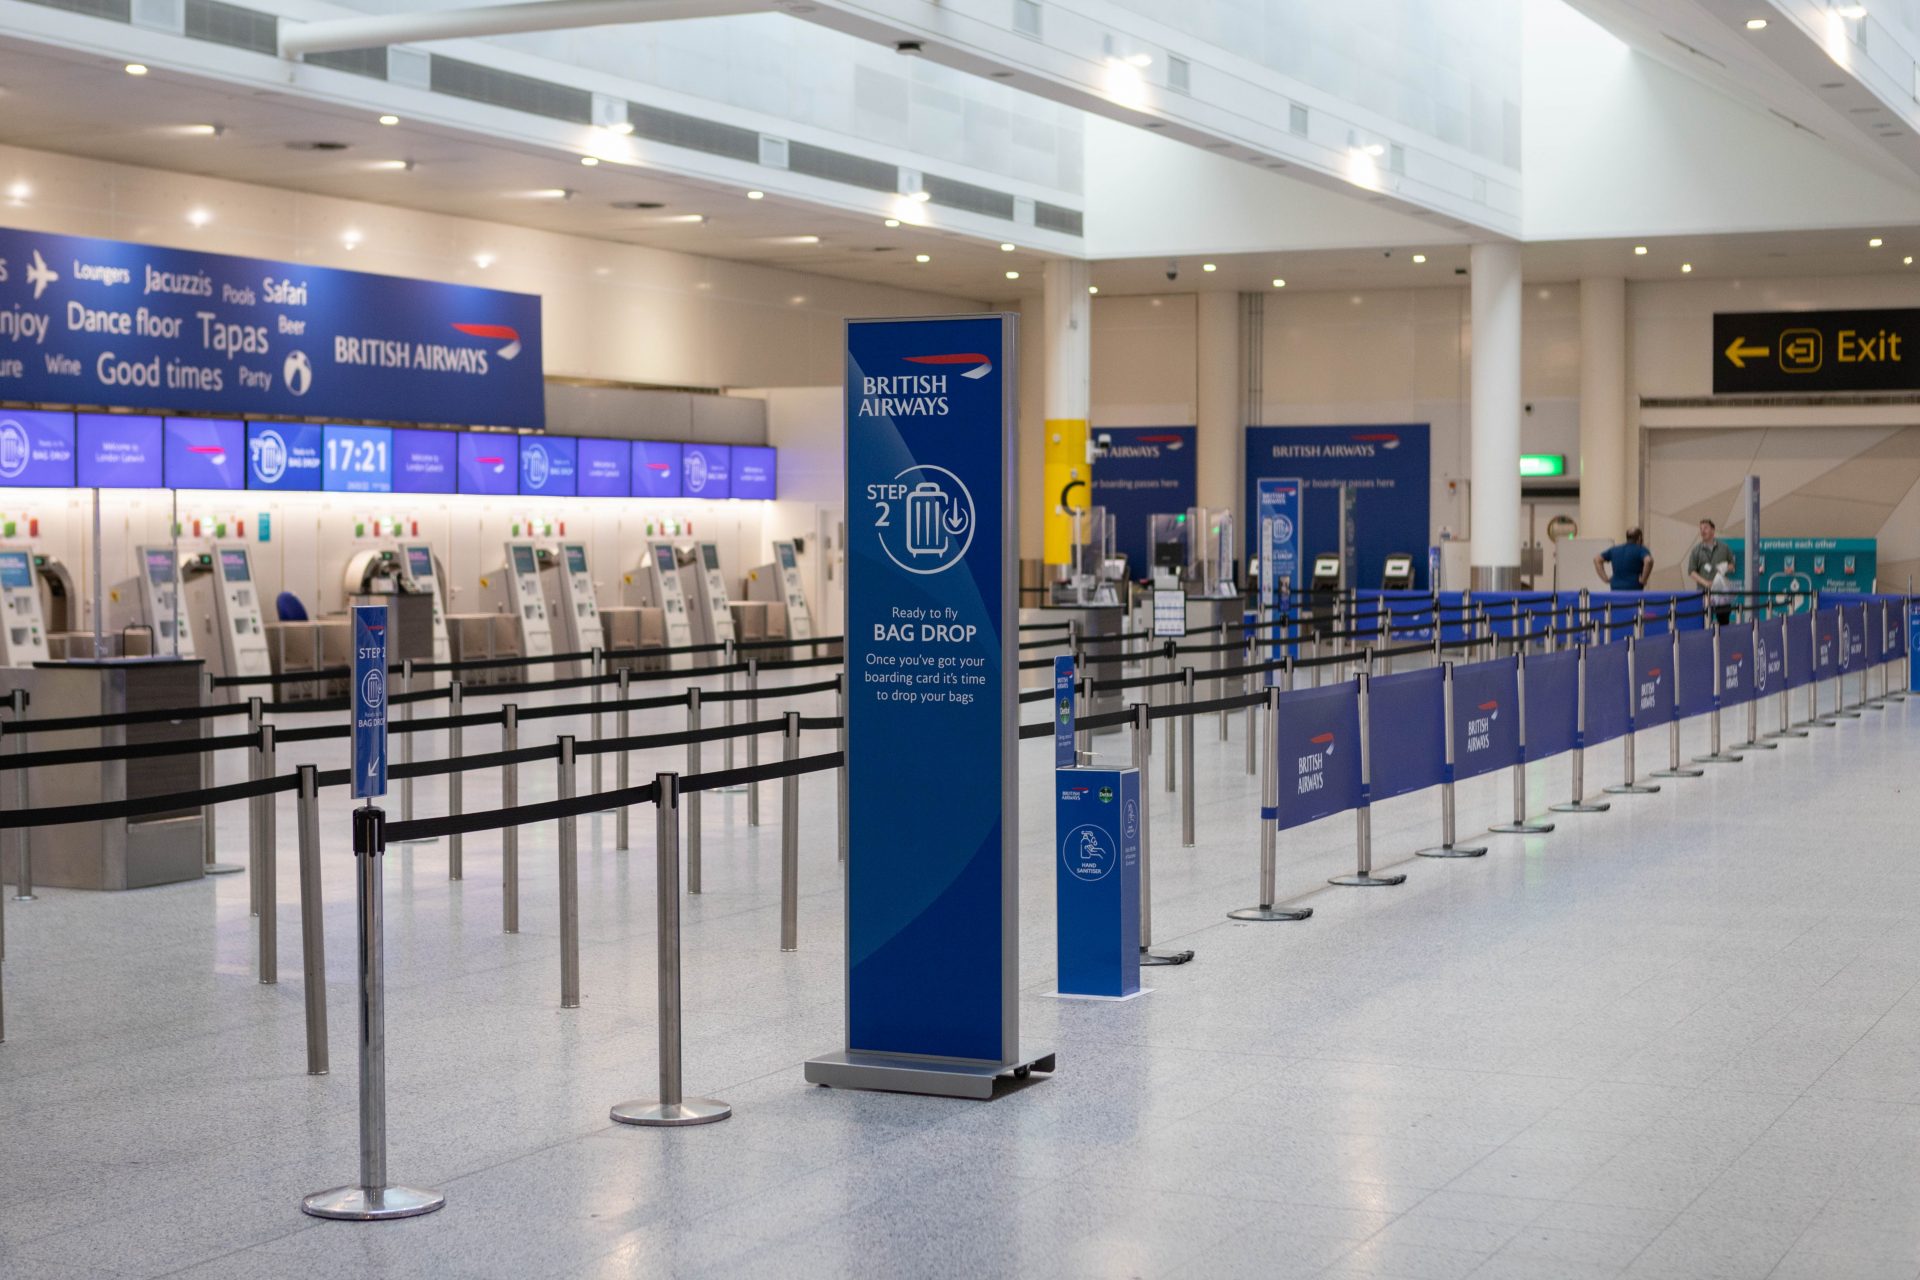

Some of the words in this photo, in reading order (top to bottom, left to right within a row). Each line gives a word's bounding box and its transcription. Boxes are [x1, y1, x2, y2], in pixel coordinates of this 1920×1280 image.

[73, 259, 131, 287] Loungers
[144, 264, 214, 297] Jacuzzis
[222, 284, 257, 306] Pools
[263, 277, 308, 306] Safari
[0, 303, 49, 344] njoy
[67, 301, 132, 336] Dance
[136, 307, 183, 339] floor
[197, 311, 269, 360] Tapas
[278, 314, 306, 336] Beer
[334, 335, 411, 369] BRITISH
[413, 343, 489, 375] AIRWAYS
[1838, 329, 1902, 362] Exit
[0, 358, 23, 378] ure
[45, 353, 82, 376] Wine
[97, 351, 160, 388] Good
[167, 357, 223, 391] times
[239, 366, 272, 392] Party
[863, 375, 947, 395] BRITISH
[858, 397, 949, 417] AIRWAYS
[327, 439, 386, 472] 17:21
[1109, 446, 1160, 458] AIRWAYS
[1272, 445, 1321, 457] BRITISH
[1322, 445, 1375, 457] AIRWAYS
[867, 484, 908, 500] STEP
[1100, 480, 1134, 490] boarding
[1134, 481, 1160, 490] passes
[1160, 479, 1179, 488] here
[1376, 479, 1395, 488] here
[1061, 480, 1086, 516] C
[874, 502, 890, 527] 2
[1764, 540, 1793, 550] protect
[1794, 540, 1814, 549] each
[1815, 540, 1837, 549] other
[892, 606, 926, 621] Ready
[930, 608, 942, 619] to
[944, 607, 959, 621] fly
[873, 623, 915, 642] BAG
[921, 624, 977, 643] DROP
[359, 647, 381, 660] STEP
[865, 653, 896, 665] Once
[899, 654, 935, 668] you've
[938, 656, 956, 669] got
[959, 657, 985, 669] your
[865, 671, 913, 686] boarding
[915, 672, 940, 684] card
[943, 673, 958, 685] it's
[961, 674, 987, 685] time
[876, 690, 889, 701] to
[891, 690, 918, 704] drop
[920, 692, 946, 704] your
[949, 691, 975, 705] bags
[1641, 682, 1655, 697] BRITISH
[358, 719, 373, 728] BAG
[1468, 717, 1489, 736] BRITISH
[1467, 733, 1489, 752] AIRWAYS
[1298, 752, 1323, 775] BRITISH
[1297, 772, 1324, 796] AIRWAYS
